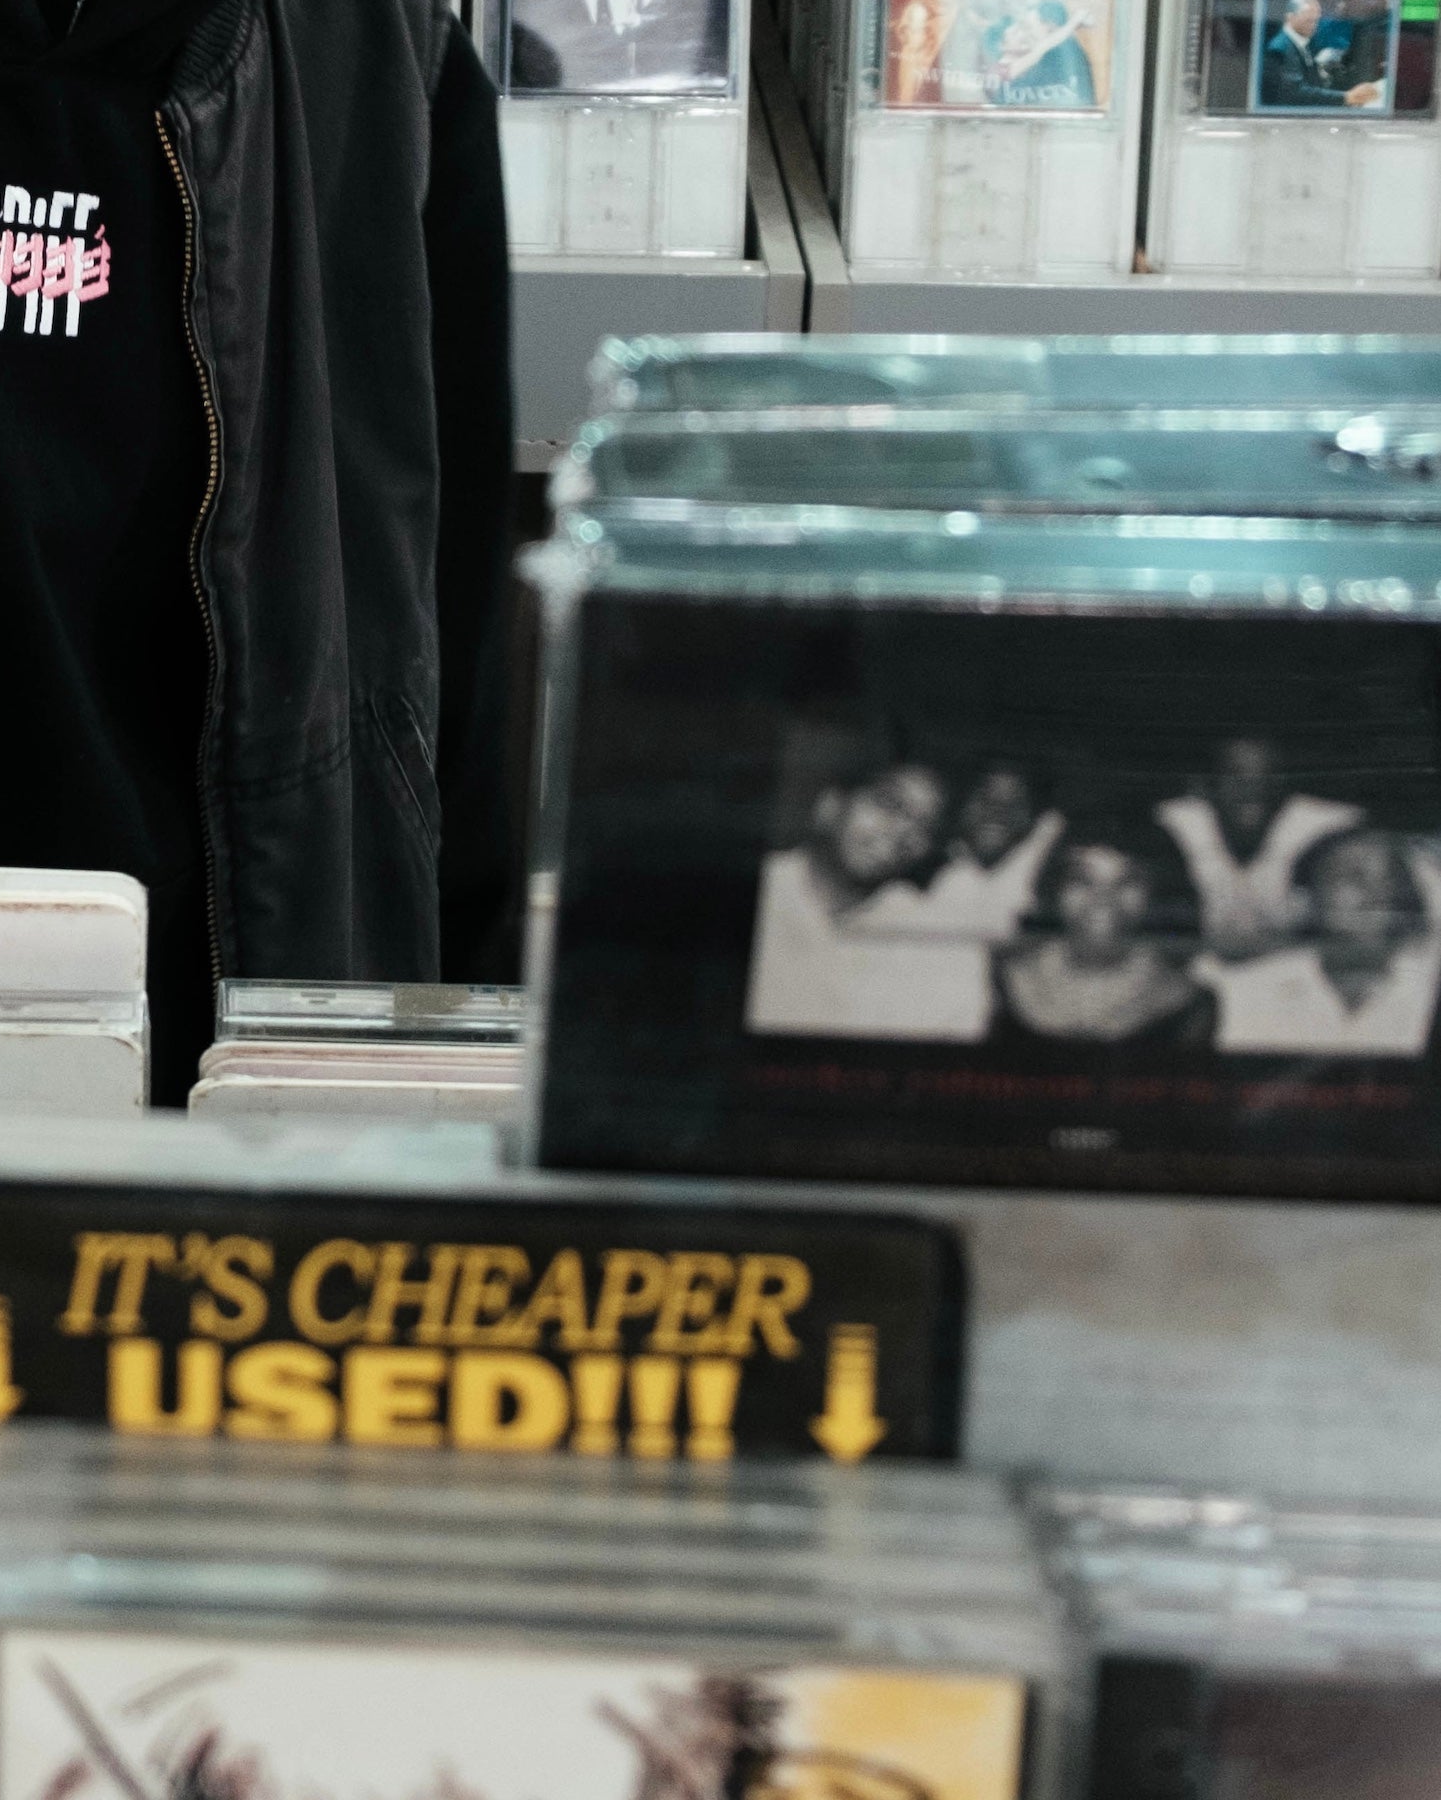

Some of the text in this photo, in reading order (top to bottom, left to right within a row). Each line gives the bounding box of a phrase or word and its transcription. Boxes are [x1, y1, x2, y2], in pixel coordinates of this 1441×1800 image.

[60, 1230, 814, 1360] IT'S CHEAPER
[107, 1336, 741, 1461] USED!!!
